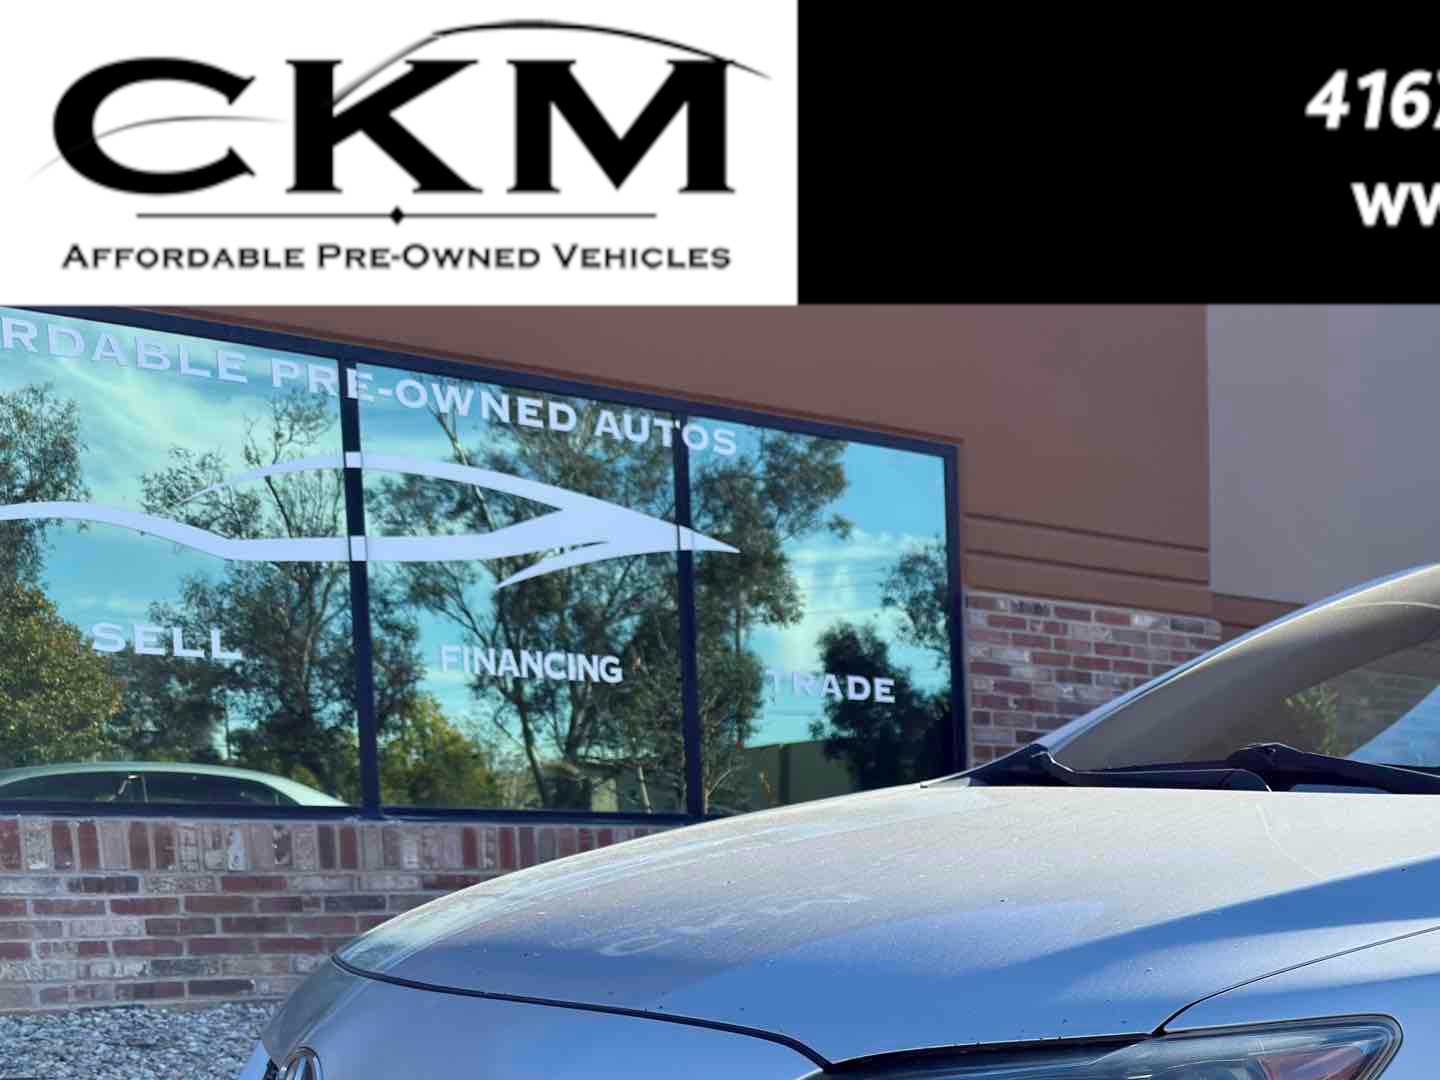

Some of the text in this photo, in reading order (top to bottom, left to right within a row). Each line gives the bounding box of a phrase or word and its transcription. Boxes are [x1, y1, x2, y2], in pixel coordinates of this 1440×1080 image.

[270, 357, 577, 433] PRE-OWNED
[595, 414, 737, 456] AUTOS
[91, 622, 243, 661] SELL
[440, 645, 624, 683] FINANCING
[766, 668, 896, 704] TRADE
